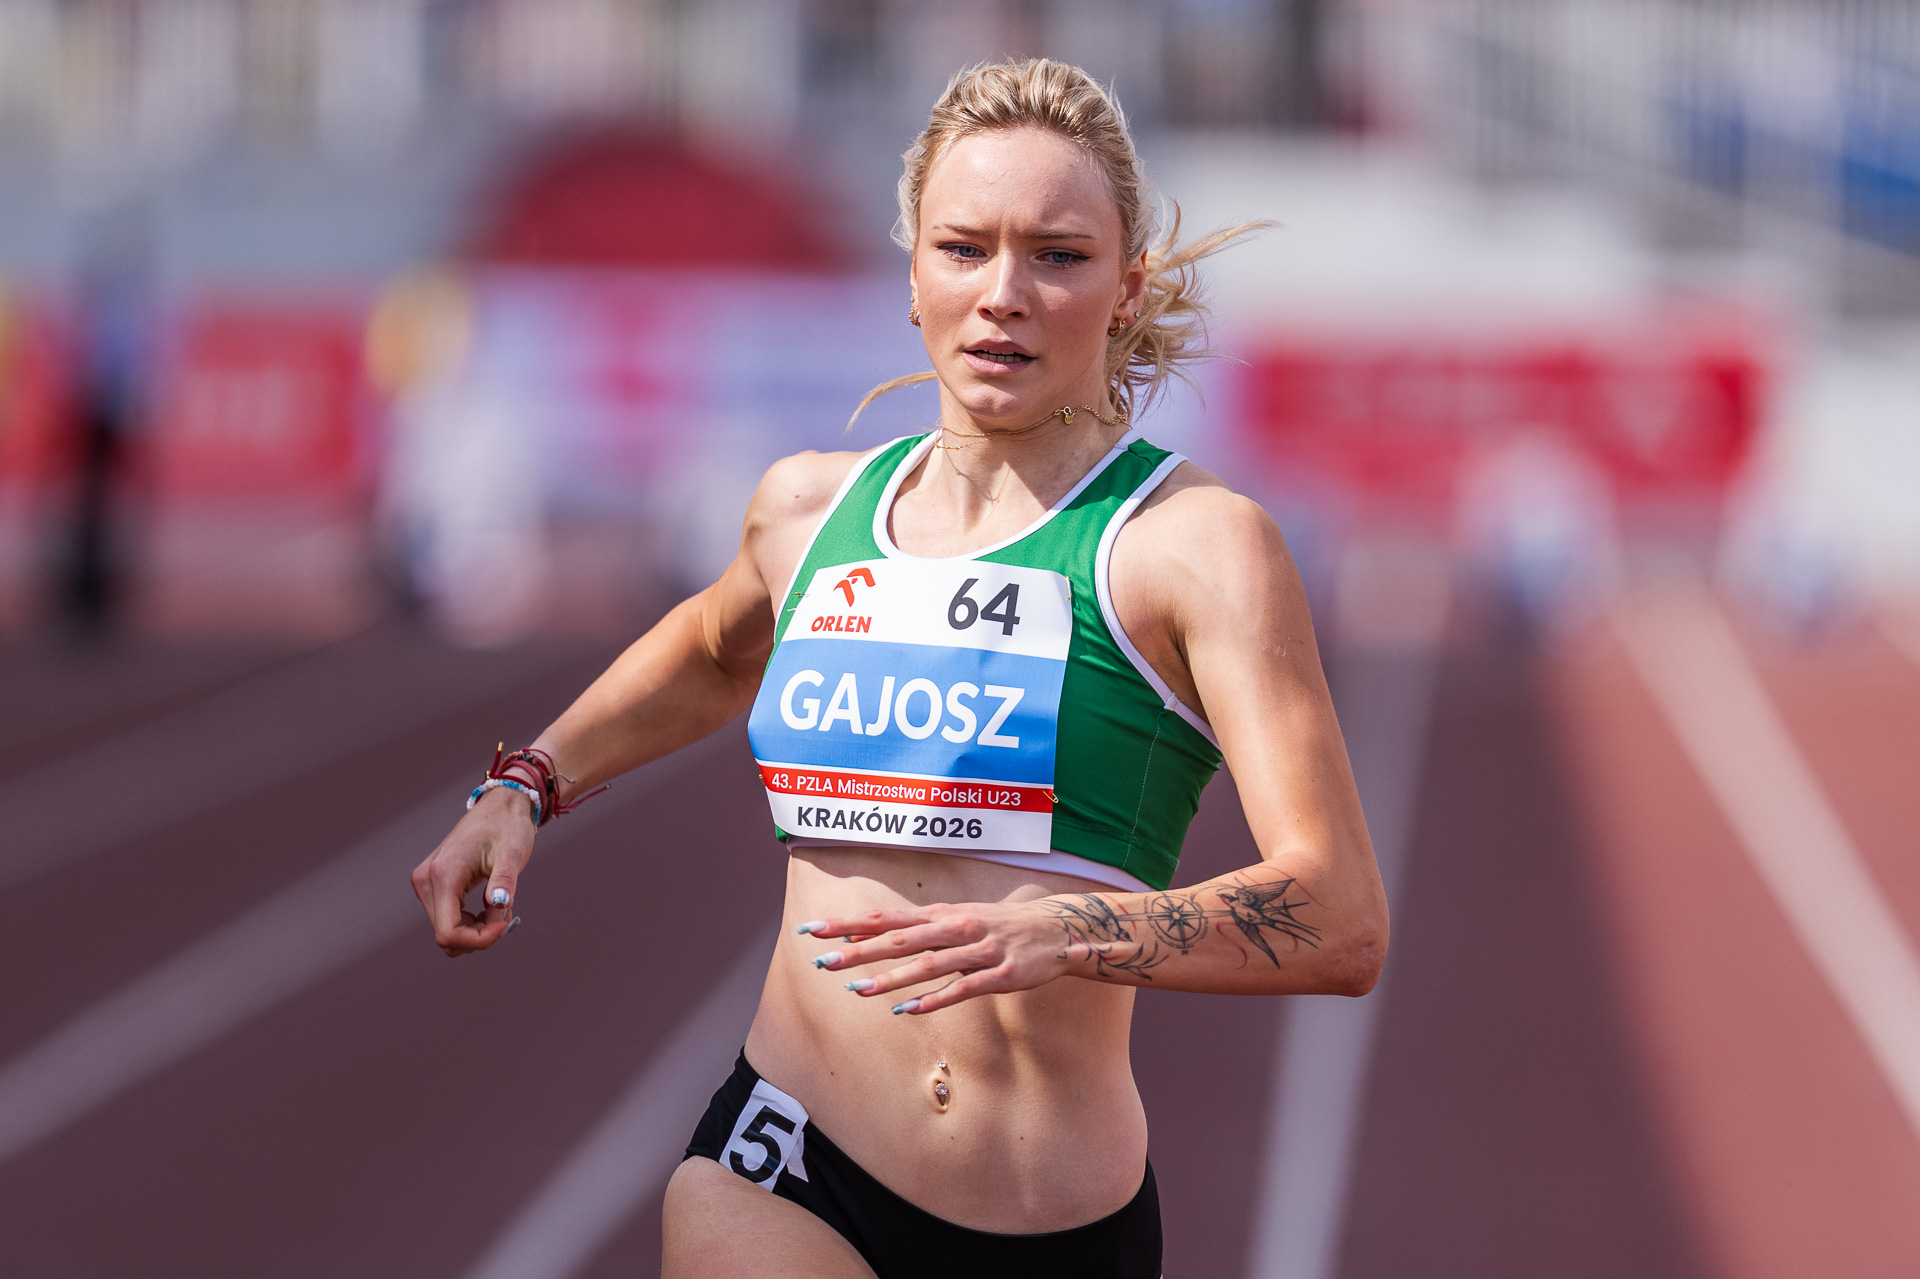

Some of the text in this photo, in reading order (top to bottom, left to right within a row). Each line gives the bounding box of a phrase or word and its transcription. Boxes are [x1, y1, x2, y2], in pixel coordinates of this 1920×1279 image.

[811, 616, 872, 633] ORLEN
[948, 578, 1020, 636] 64
[780, 669, 1025, 748] GAJOSZ
[772, 773, 1022, 807] 43. PZLA Mistrzostwa Polski U23
[797, 805, 983, 839] KRAKÓW 2026
[729, 1105, 797, 1183] 5
